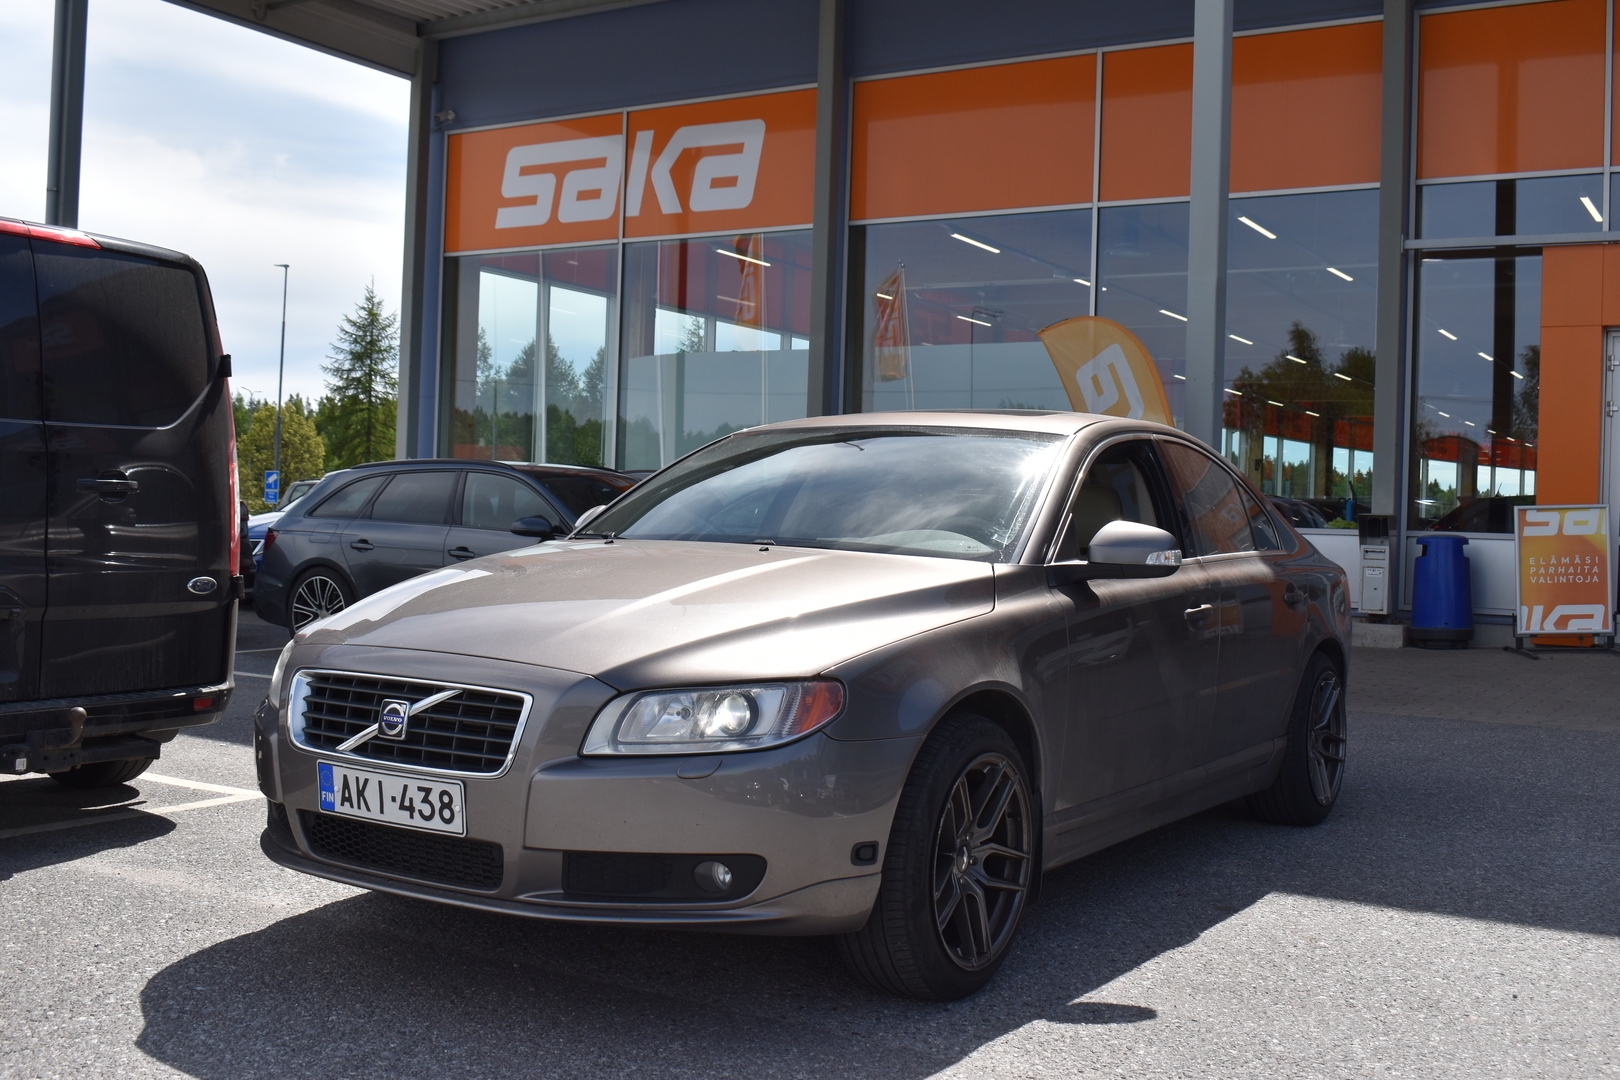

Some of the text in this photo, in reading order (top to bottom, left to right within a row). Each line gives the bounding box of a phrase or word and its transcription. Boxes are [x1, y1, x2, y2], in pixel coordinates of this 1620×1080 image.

[1529, 555, 1599, 565] ELÄMÄSI
[1529, 566, 1599, 575] PARHAITA
[1529, 575, 1599, 584] VALINTOJA
[383, 715, 403, 723] VOLVO
[321, 791, 334, 803] FIN
[340, 773, 455, 825] AKI-438
